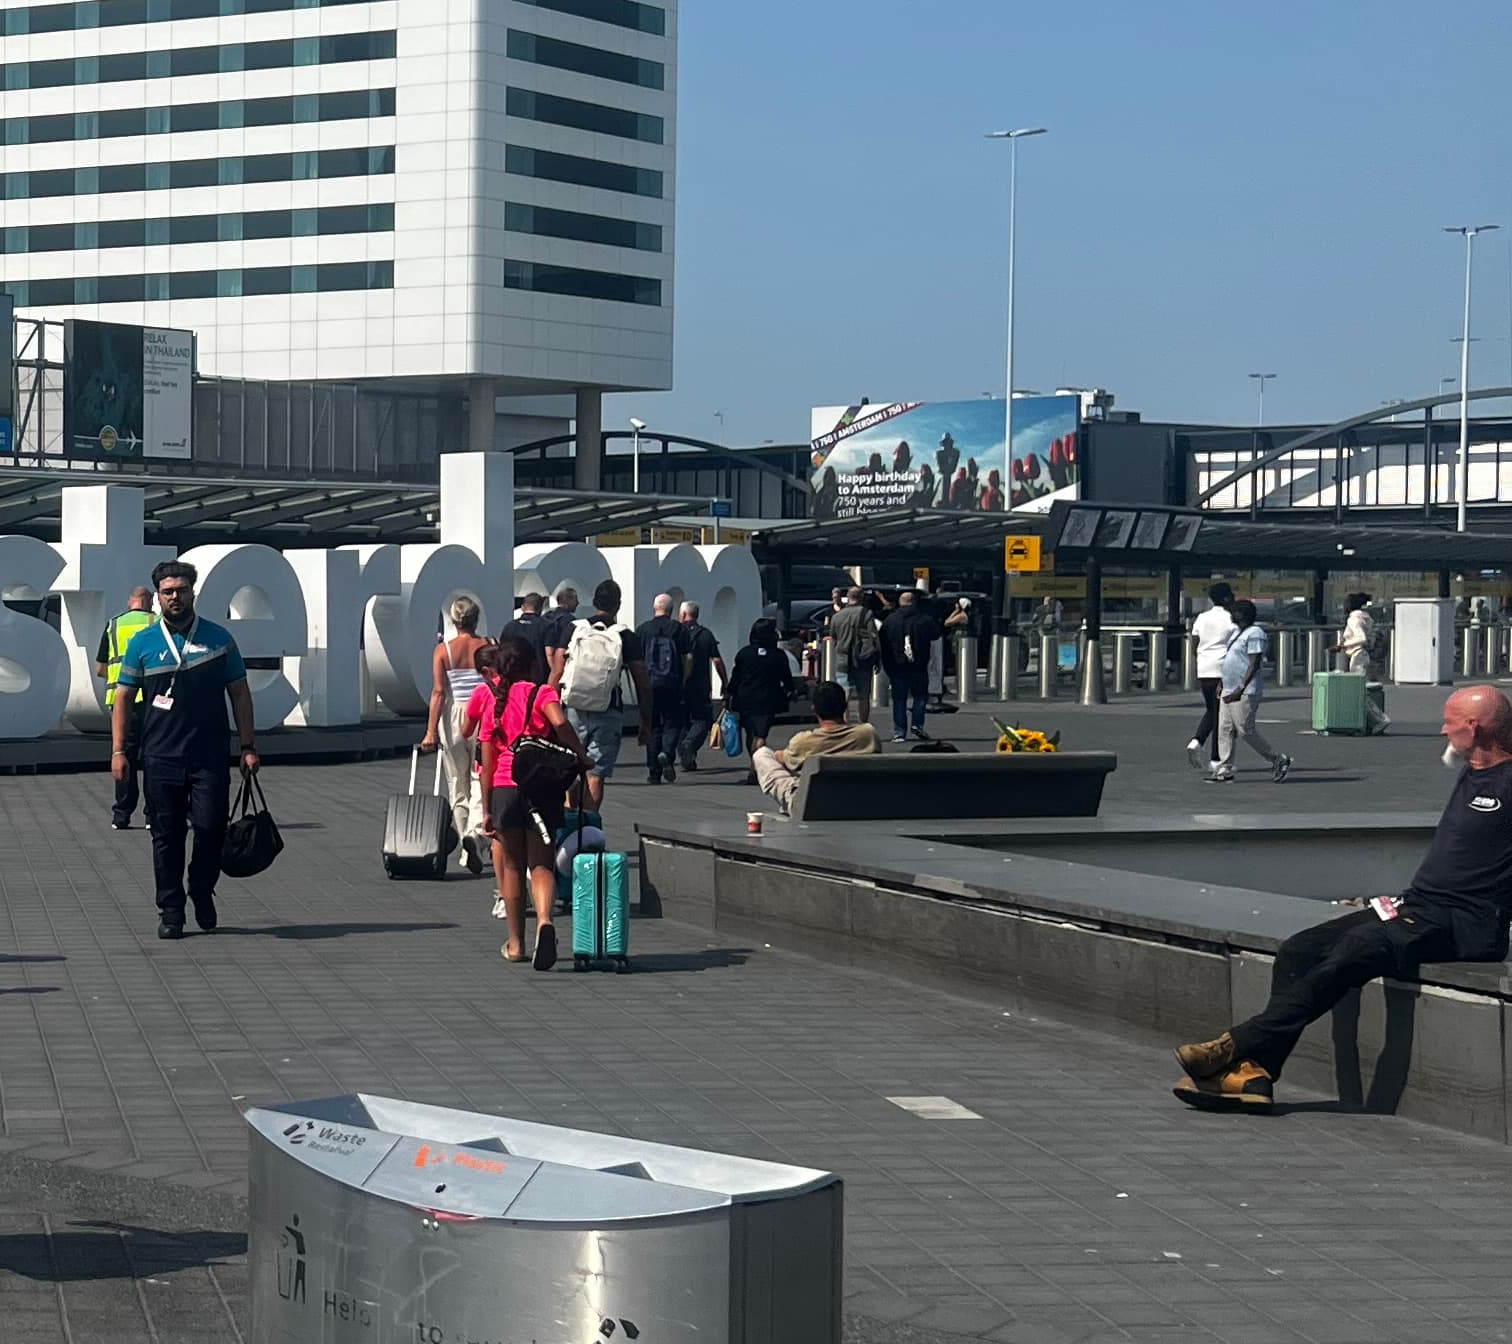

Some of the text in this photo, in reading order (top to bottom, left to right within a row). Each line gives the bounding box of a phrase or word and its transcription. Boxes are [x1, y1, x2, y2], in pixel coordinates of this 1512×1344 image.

[838, 413, 883, 440] AMSTERDAM
[838, 471, 921, 485] Happy birthday
[838, 483, 915, 495] to Amsterdam
[838, 494, 906, 508] 750 years and
[318, 1126, 367, 1147] Waste
